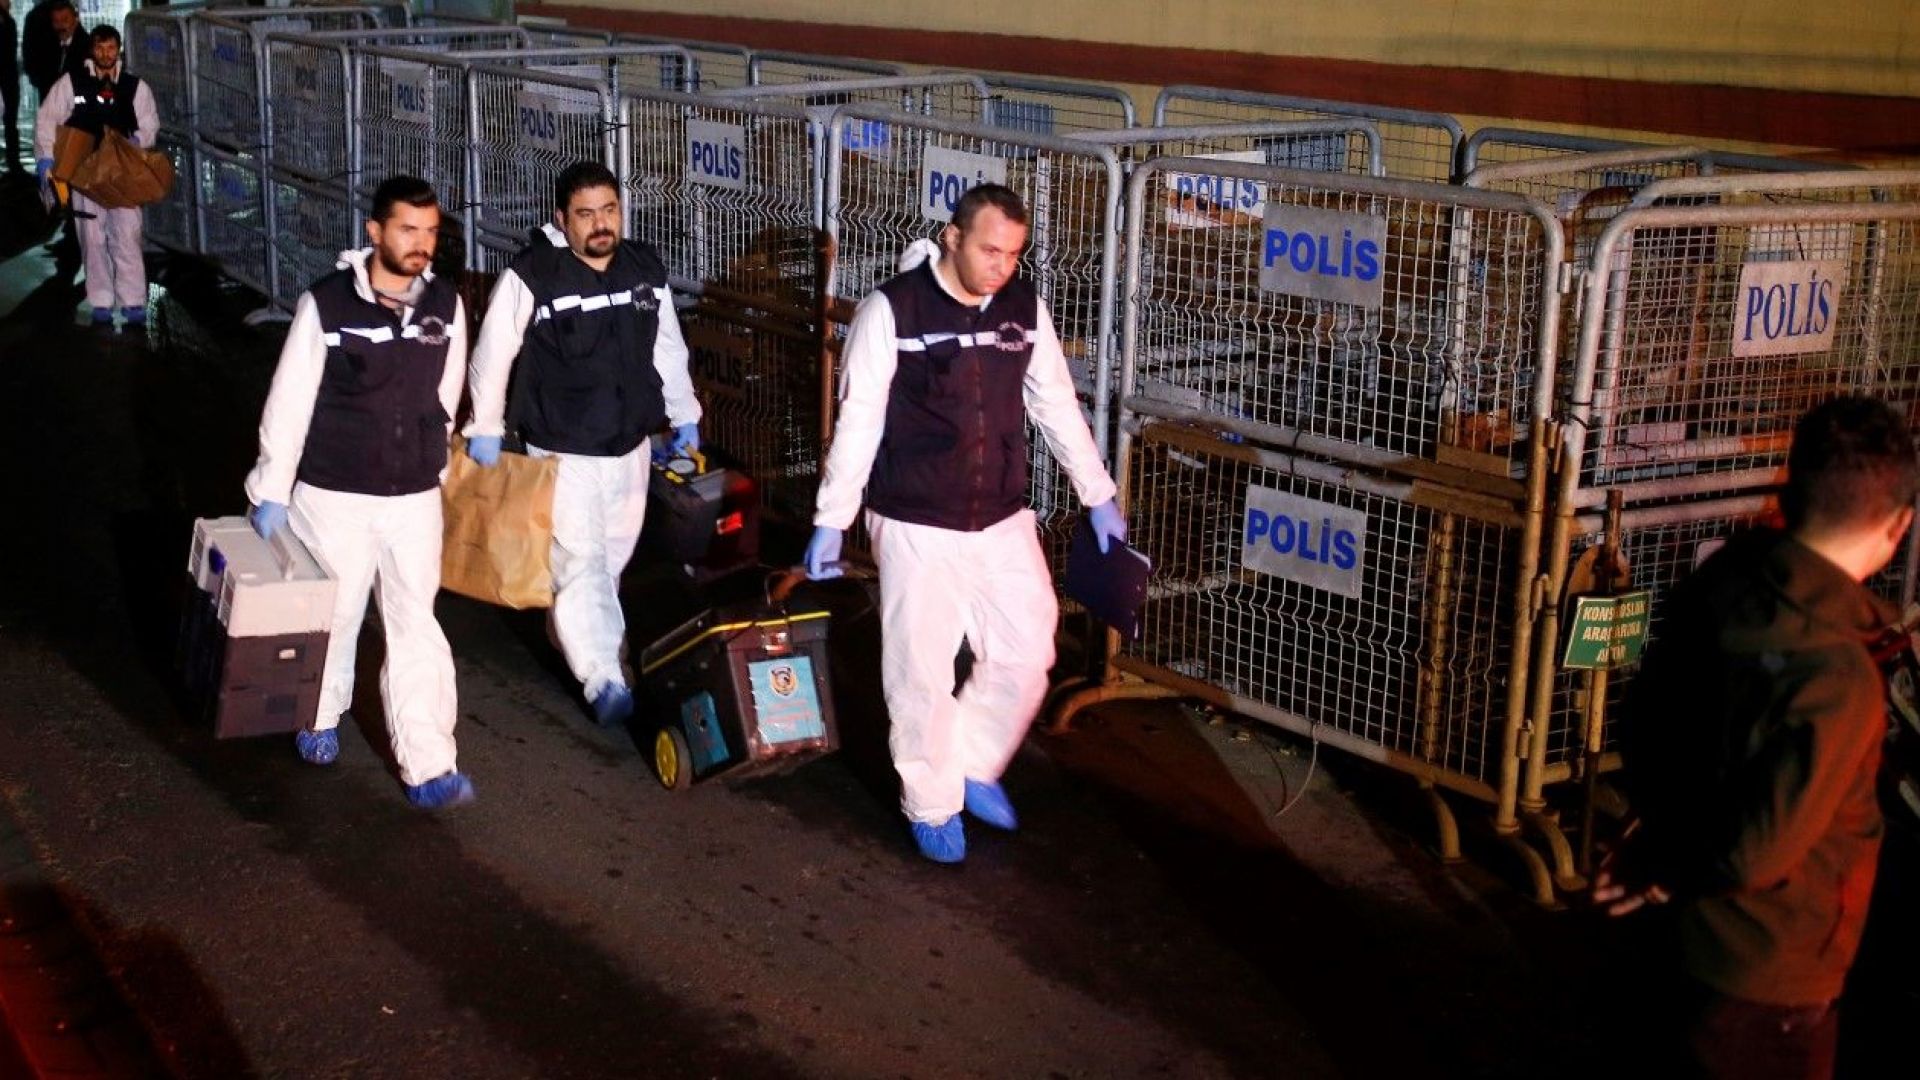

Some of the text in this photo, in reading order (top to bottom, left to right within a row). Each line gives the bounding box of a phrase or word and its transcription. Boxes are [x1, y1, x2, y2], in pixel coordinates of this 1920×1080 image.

[692, 136, 741, 180] POLİS
[1265, 229, 1378, 281] POLİS
[1743, 269, 1832, 341] POLİS
[1246, 508, 1356, 570] POLİS
